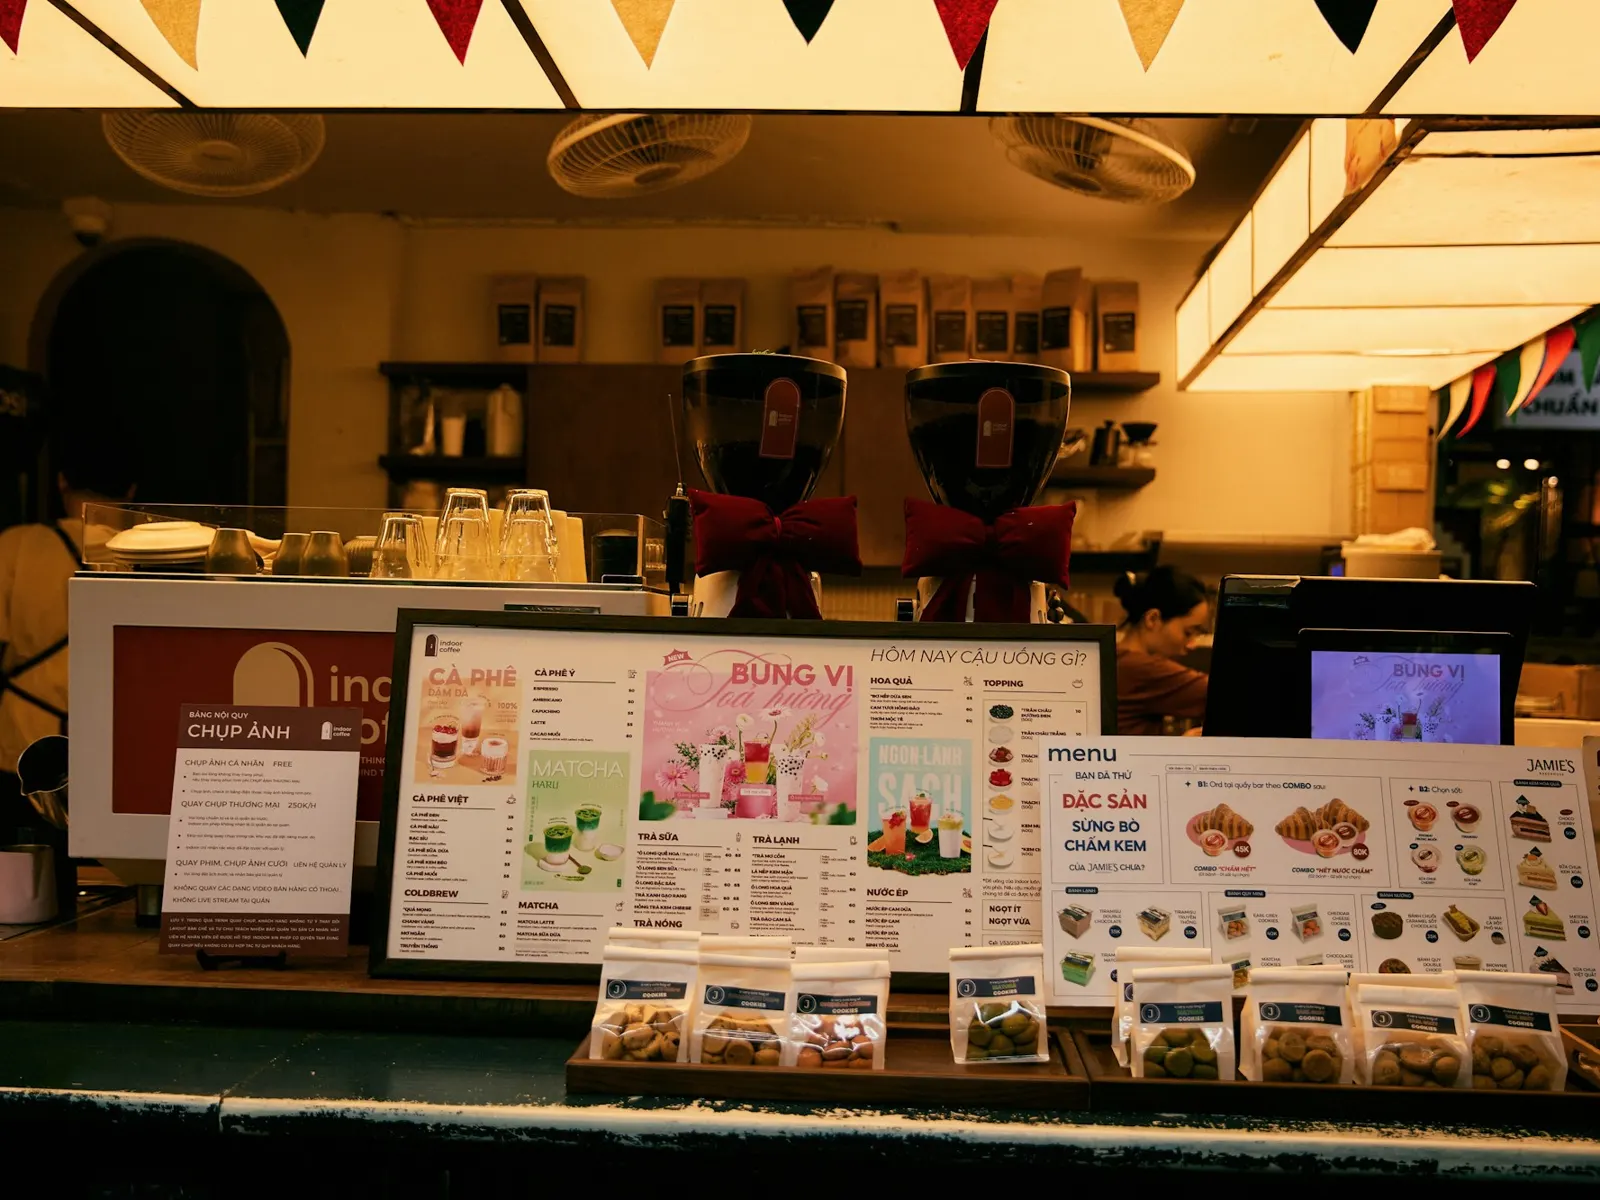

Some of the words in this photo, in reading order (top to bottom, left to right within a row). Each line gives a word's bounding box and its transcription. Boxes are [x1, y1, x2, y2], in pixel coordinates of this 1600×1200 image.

[667, 652, 685, 662] NEW
[871, 646, 916, 662] HÔM
[920, 650, 957, 663] NAY
[960, 648, 999, 667] CẬU
[1003, 647, 1056, 666] UỐNG
[1061, 649, 1087, 666] GÌ?
[429, 663, 463, 686] CÀ
[470, 665, 517, 687] PHÊ
[534, 667, 547, 677] CÀ
[549, 668, 568, 677] PHÊ
[1393, 663, 1443, 678] BUNG
[1447, 664, 1464, 682] VỊ
[732, 662, 817, 686] BUNG
[824, 665, 853, 693] VỊ
[870, 677, 891, 685] HOA
[892, 675, 913, 686] QUẢ
[983, 679, 1024, 688] TOPPING
[497, 702, 518, 710] 100%
[189, 710, 213, 719] BẢNG
[214, 711, 229, 720] NỘI
[230, 711, 249, 720] QUY
[187, 723, 243, 742] CHỤP
[247, 720, 290, 740] ẢNH
[1048, 747, 1117, 762] menu
[185, 760, 207, 768] CHỤP
[208, 758, 227, 767] ẢNH
[228, 759, 240, 767] CÁ
[241, 759, 265, 768] NHÂN
[273, 760, 293, 768] FREE
[1526, 758, 1576, 774] JAMIE'S
[532, 759, 624, 778] MATCHA
[1075, 771, 1094, 781] BẠN
[1097, 770, 1110, 780] ĐÃ
[1112, 769, 1133, 780] THỬ
[532, 780, 559, 790] HARU
[1197, 780, 1209, 788] B1:
[1224, 781, 1233, 790] tại
[1252, 781, 1264, 789] bar
[1265, 782, 1281, 790] theo
[1282, 782, 1312, 790] COMBO
[1418, 785, 1431, 793] B2:
[1431, 785, 1449, 795] Chọn
[412, 793, 426, 803] CÀ
[427, 794, 446, 804] PHÊ
[447, 795, 469, 806] VIỆT
[1062, 789, 1102, 812] ĐẶC
[1107, 788, 1147, 809] SẢN
[181, 800, 203, 809] QUAY
[204, 801, 228, 810] CHỤP
[229, 801, 264, 809] THƯƠNG
[265, 802, 280, 811] MẠI
[288, 802, 317, 810] 250K/H
[1072, 817, 1115, 832] SỪNG
[1119, 817, 1140, 832] BÒ
[638, 832, 657, 841] TRÀ
[658, 832, 679, 842] SỮA
[752, 835, 771, 844] TRÀ
[773, 836, 800, 846] LẠNH
[1064, 835, 1110, 852] CHẤM
[1114, 839, 1147, 852] KEM
[1234, 845, 1250, 854] 45K
[1352, 847, 1368, 857] 80K
[175, 859, 198, 868] QUAY
[199, 860, 222, 869] PHIM,
[224, 860, 247, 869] CHỤP
[248, 858, 266, 868] ẢNH
[267, 859, 288, 868] CƯỚI
[293, 860, 307, 869] LIÊN
[308, 861, 319, 870] HỆ
[319, 861, 338, 870] QUẢN
[1068, 862, 1085, 871] CỦA
[1087, 862, 1119, 872] JAMIE'S
[1119, 863, 1146, 872] CHƯA?
[1193, 865, 1217, 873] COMBO
[1292, 867, 1315, 875] COMBO
[173, 884, 198, 892] KHÔNG
[252, 885, 273, 893] VIDEO
[288, 885, 307, 893] HÀNG
[404, 889, 459, 898] COLDBREW
[866, 887, 895, 897] NƯỚC
[896, 888, 909, 897] ÉP
[172, 896, 196, 904] KHÔNG
[240, 897, 250, 905] TẠI
[251, 896, 270, 905] QUÁN
[518, 901, 559, 910] MATCHA
[989, 905, 1012, 915] NGỌT
[1014, 904, 1022, 913] ÍT
[633, 918, 653, 928] TRÀ
[654, 918, 683, 928] NÓNG
[989, 917, 1012, 927] NGỌT
[1013, 916, 1031, 926] VỪA
[741, 1000, 767, 1009] COOKIES
[1411, 1023, 1438, 1032] COOKIES
[1507, 1019, 1534, 1028] COOKIES
